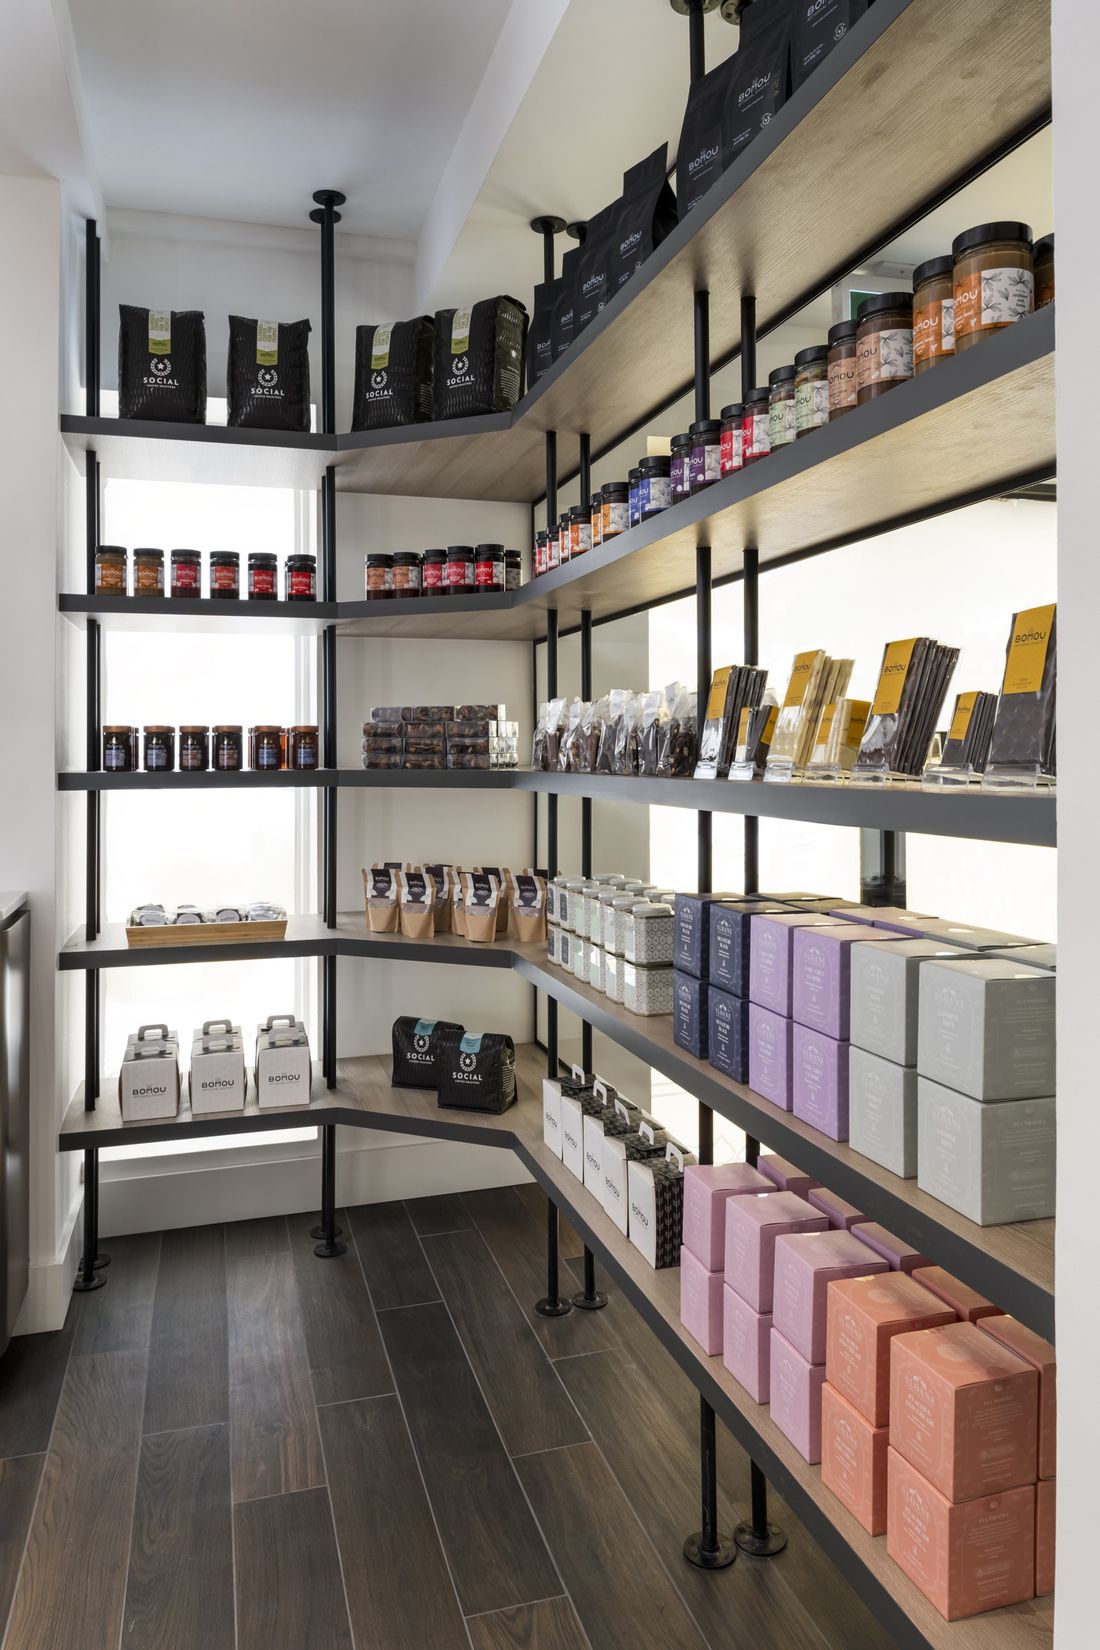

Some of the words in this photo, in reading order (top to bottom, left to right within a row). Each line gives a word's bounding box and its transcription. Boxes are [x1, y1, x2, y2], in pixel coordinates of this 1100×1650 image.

[738, 72, 771, 102] BOMOU
[688, 145, 719, 172] BOMOU
[143, 376, 180, 386] SOCIAL
[446, 374, 475, 386] SOCIAL
[250, 387, 285, 396] SOCIAL
[366, 389, 394, 399] SOCIAL
[1015, 632, 1046, 643] BOMOU
[406, 1052, 436, 1062] SOCIAL
[268, 1074, 300, 1083] BOMOU
[452, 1071, 483, 1081] SOCIAL
[202, 1080, 235, 1089] BOMOU
[132, 1086, 166, 1096] BOMOU
